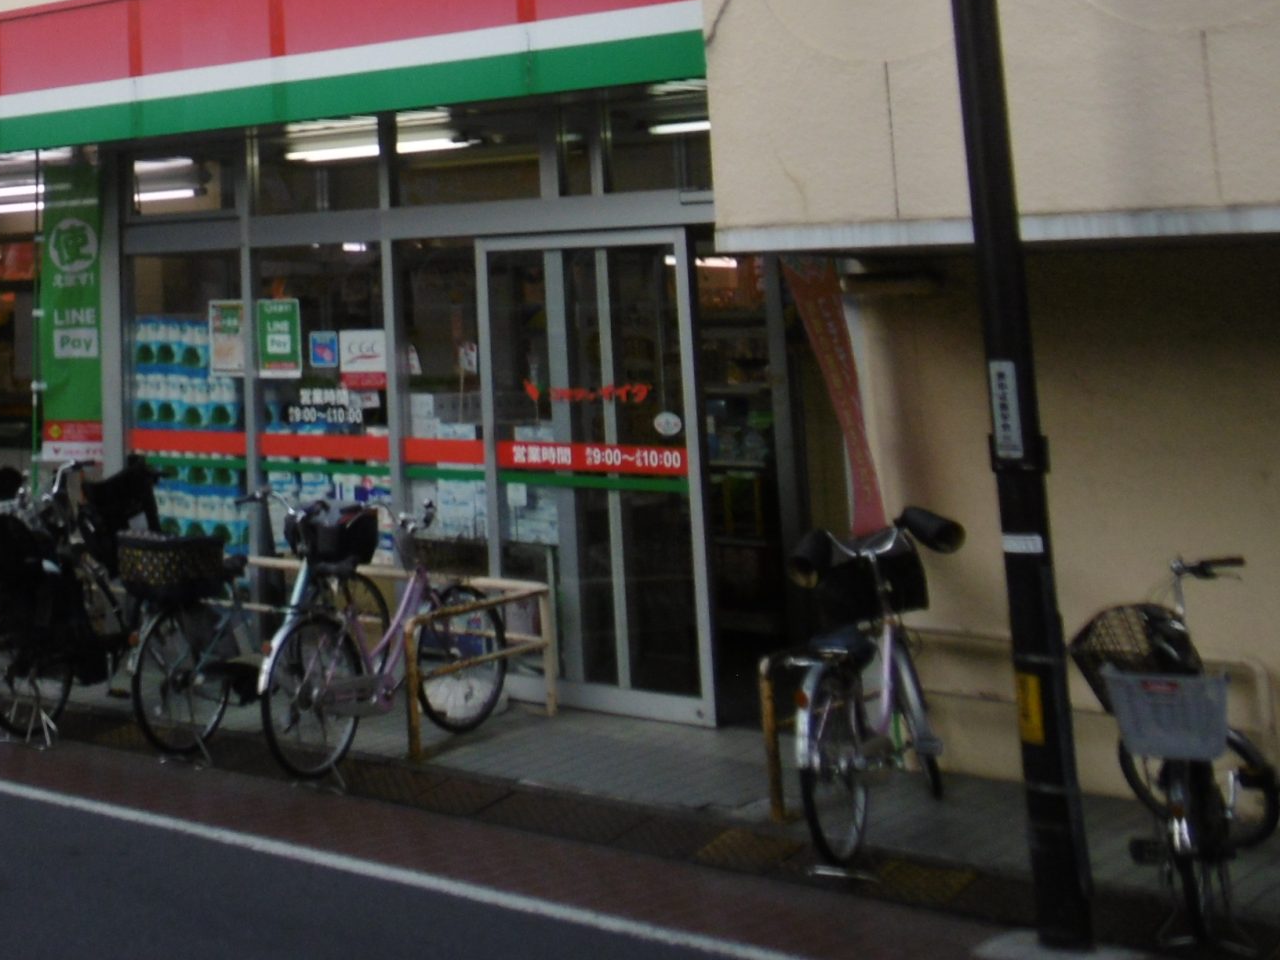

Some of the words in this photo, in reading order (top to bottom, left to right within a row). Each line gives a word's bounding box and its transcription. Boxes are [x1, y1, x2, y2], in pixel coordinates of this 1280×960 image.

[54, 308, 96, 325] LINE
[60, 335, 93, 352] Pay
[512, 444, 572, 466] 営業時間
